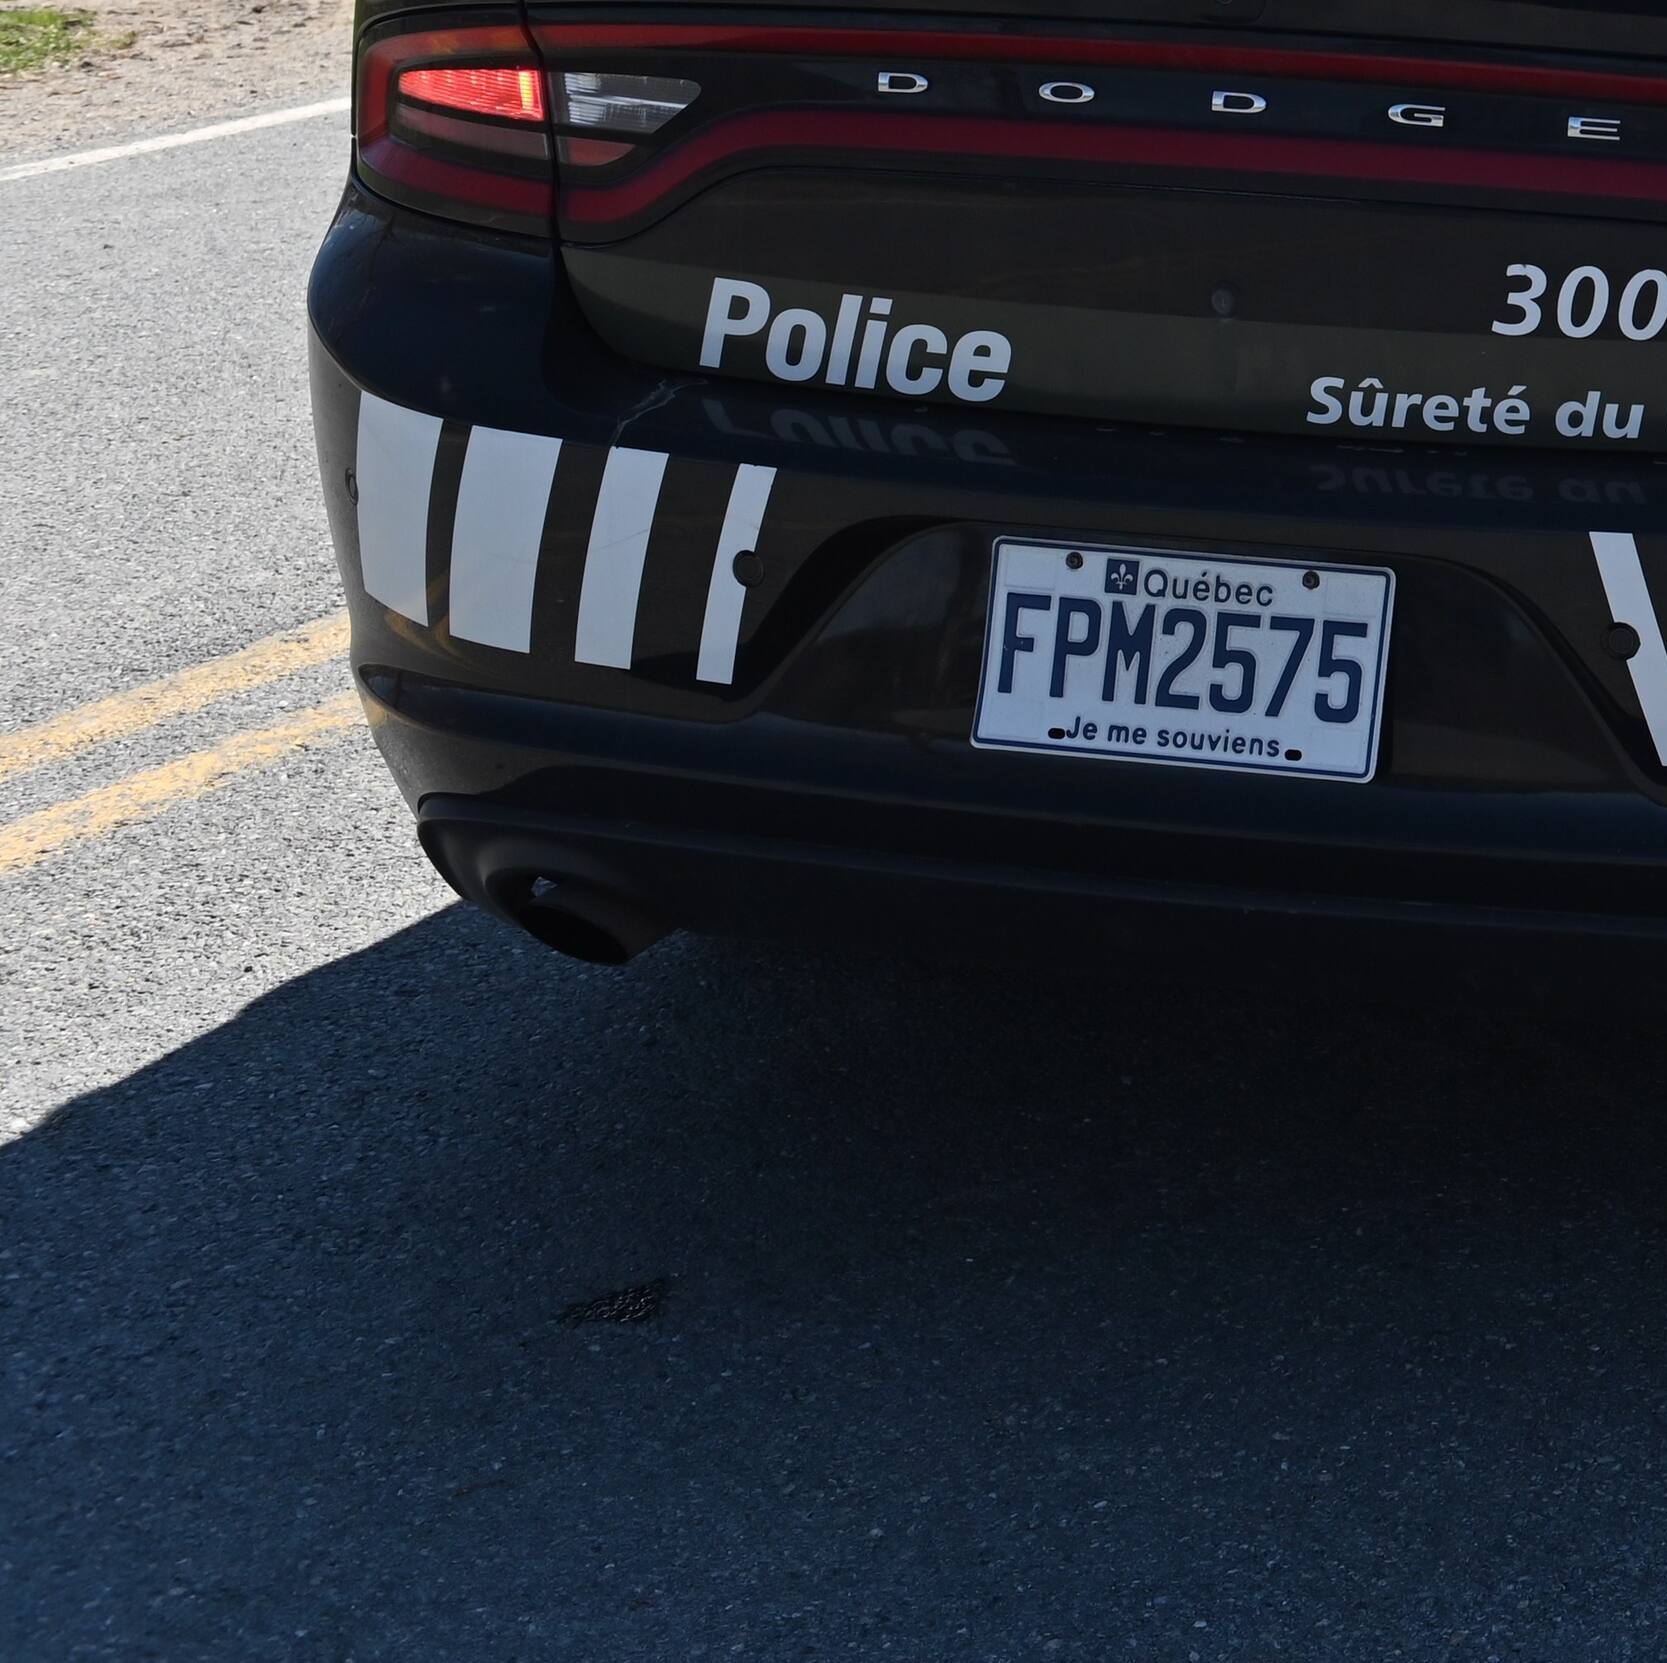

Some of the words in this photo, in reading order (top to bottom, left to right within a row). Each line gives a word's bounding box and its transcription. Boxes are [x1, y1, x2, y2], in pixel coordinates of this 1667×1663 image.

[876, 71, 1622, 141] DODGE
[700, 277, 1012, 404] Police
[1305, 375, 1531, 436] Sûreté
[1555, 387, 1644, 441] du
[1143, 569, 1274, 607] Québec
[997, 591, 1369, 724] FPM2575
[1065, 716, 1098, 741] Je
[1107, 723, 1147, 745] me
[1157, 729, 1281, 758] souviens
